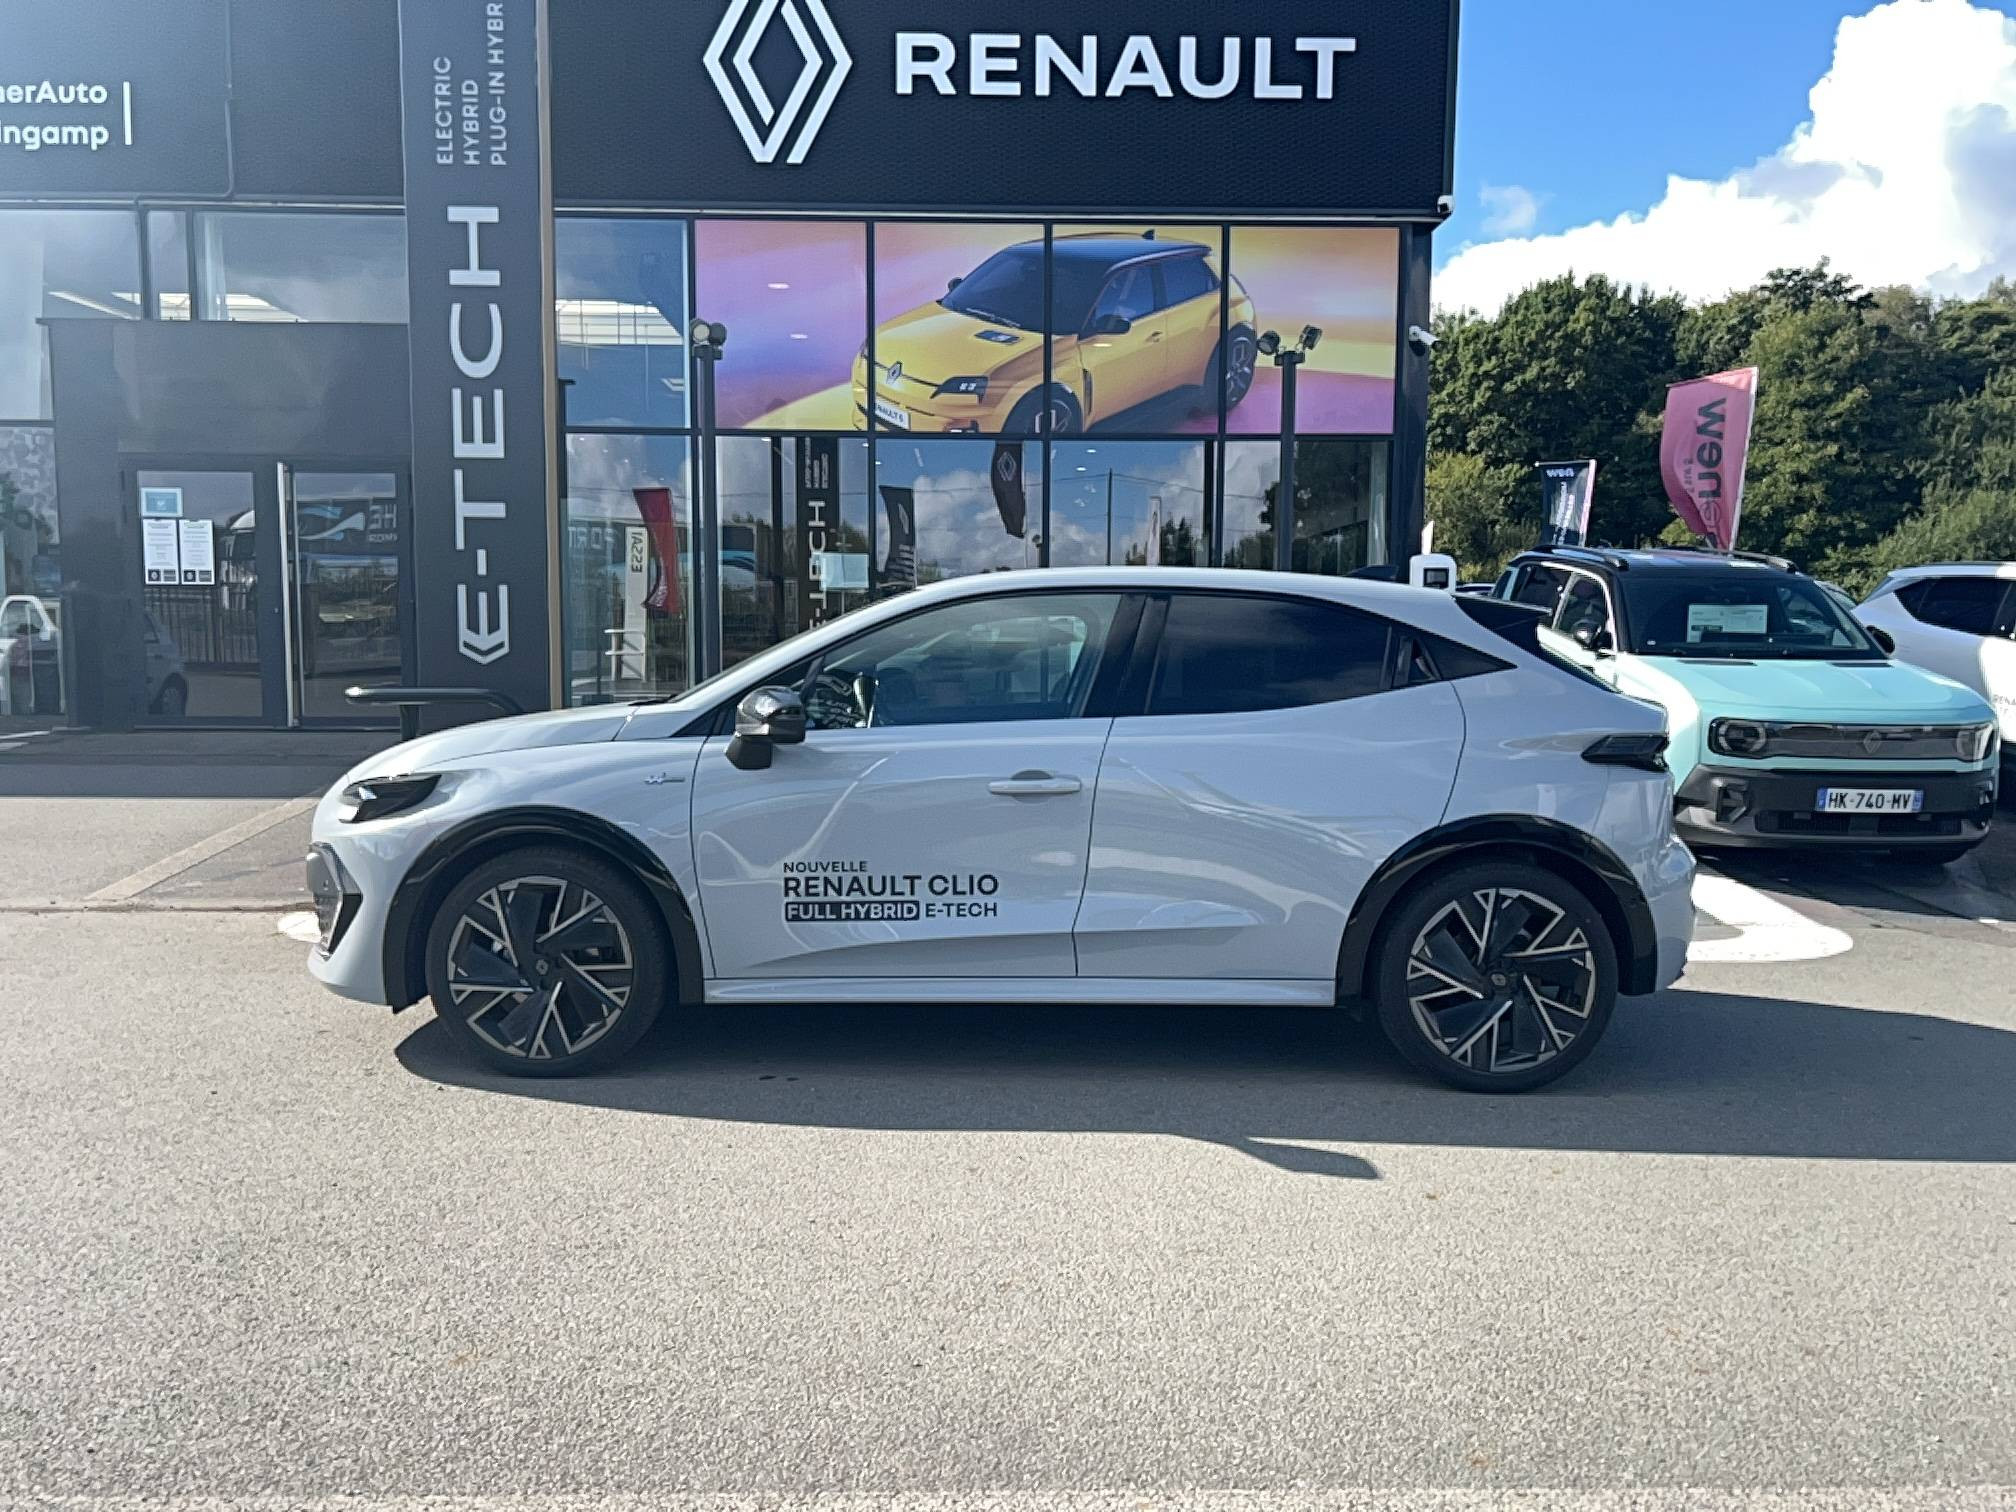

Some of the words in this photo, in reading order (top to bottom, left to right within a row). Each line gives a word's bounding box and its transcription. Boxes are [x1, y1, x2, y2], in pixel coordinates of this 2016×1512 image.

[894, 31, 1357, 100] RENAULT
[0, 124, 109, 151] ngamp
[433, 56, 453, 165] ELECTRIC
[461, 79, 480, 165] HYBRID
[488, 71, 507, 166] PLUG-IN
[446, 205, 510, 665] E-TECH
[783, 861, 868, 873] NOUVELLE
[783, 875, 922, 898] RENAULT
[927, 874, 999, 896] CLIO
[787, 903, 837, 920] FULL
[840, 902, 918, 919] HYBRID
[925, 902, 998, 918] E-TECH
